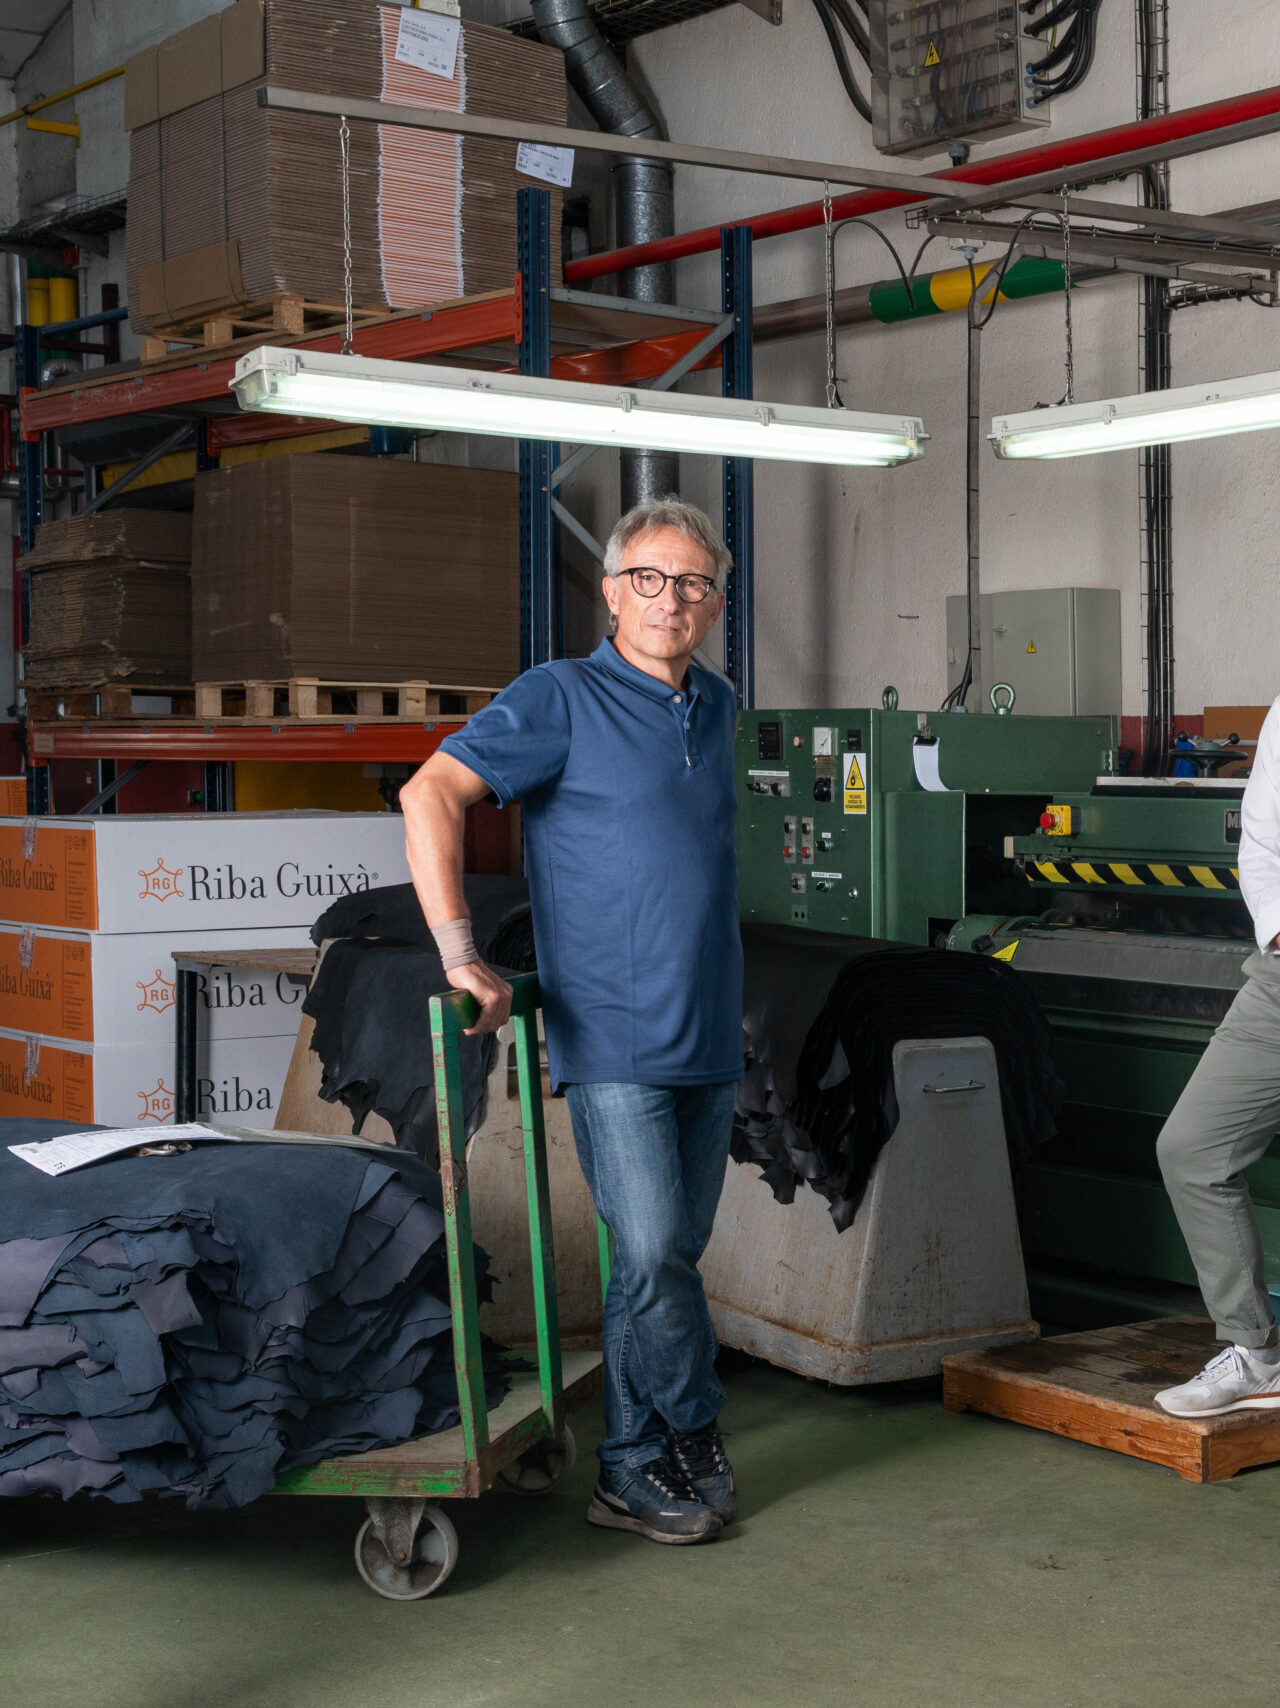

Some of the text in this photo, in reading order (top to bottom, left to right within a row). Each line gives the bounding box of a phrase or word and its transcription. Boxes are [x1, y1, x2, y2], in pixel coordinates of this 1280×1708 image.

[152, 877, 171, 891] RG
[187, 864, 268, 902] Riba
[0, 963, 18, 995] iba
[150, 988, 169, 1002] RG
[152, 1097, 171, 1112] RG
[197, 1076, 274, 1115] Riba
